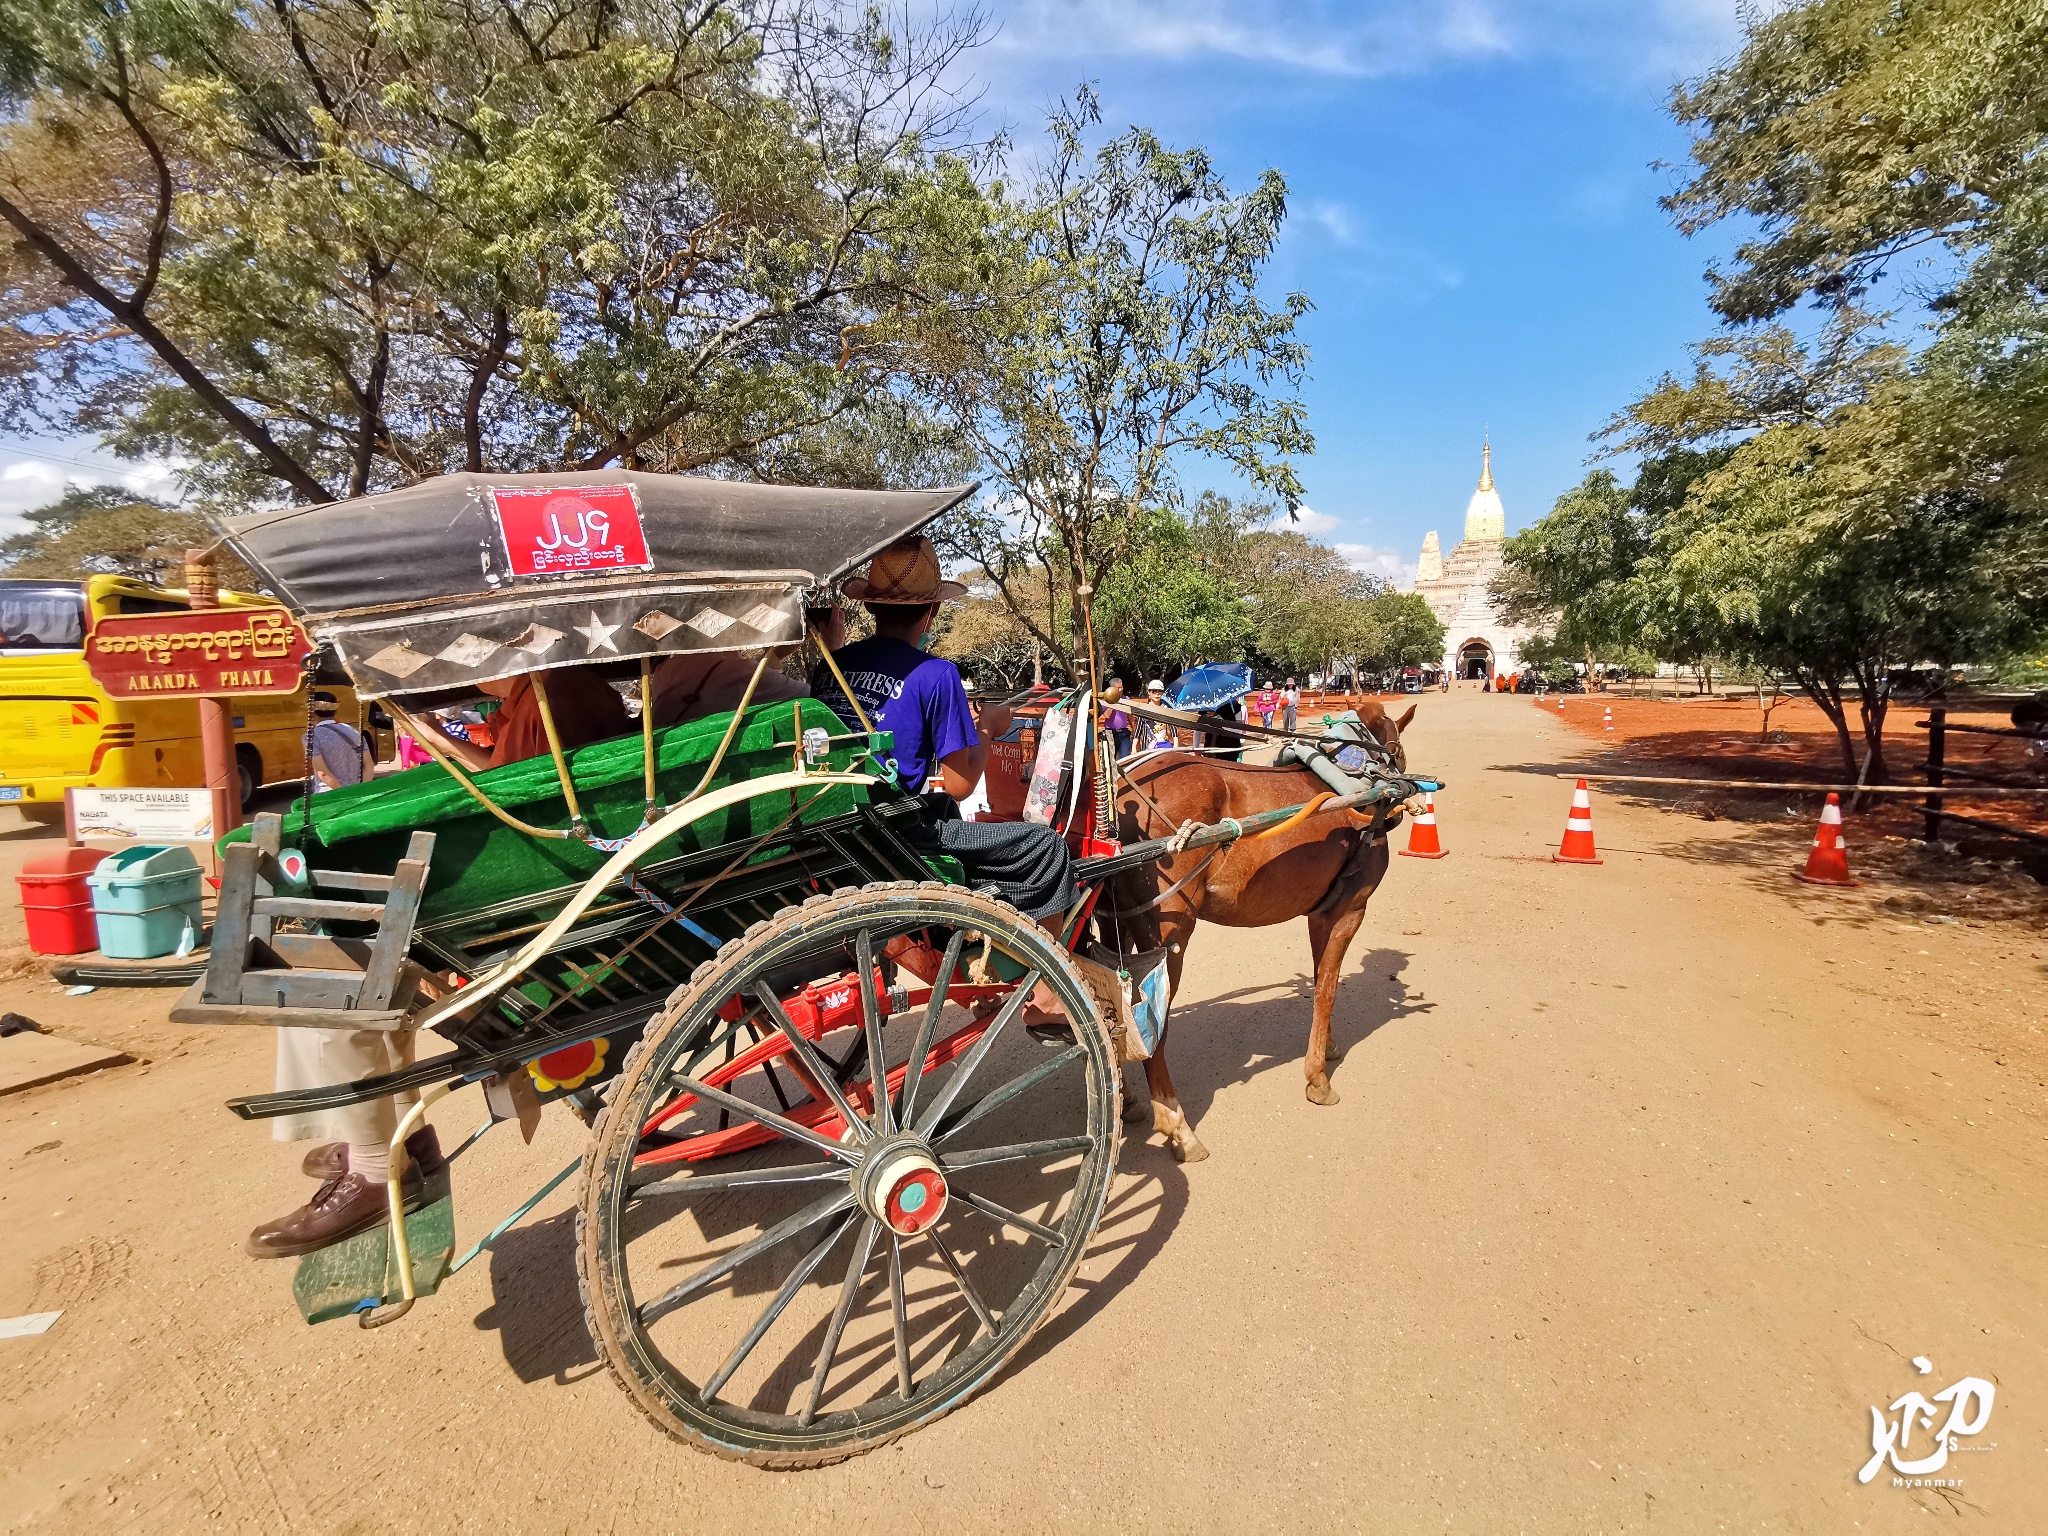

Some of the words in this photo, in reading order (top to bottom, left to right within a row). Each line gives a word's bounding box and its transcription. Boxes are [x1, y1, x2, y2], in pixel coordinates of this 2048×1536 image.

[536, 509, 610, 549] ၂၂၄
[96, 613, 295, 665] အာနန္ဒာဘုရားကြီး
[128, 673, 200, 691] ANANDA
[219, 669, 273, 687] PHAYA
[100, 793, 118, 803] THIS
[119, 793, 144, 803] SPACE
[145, 793, 190, 803] AVAILABLE
